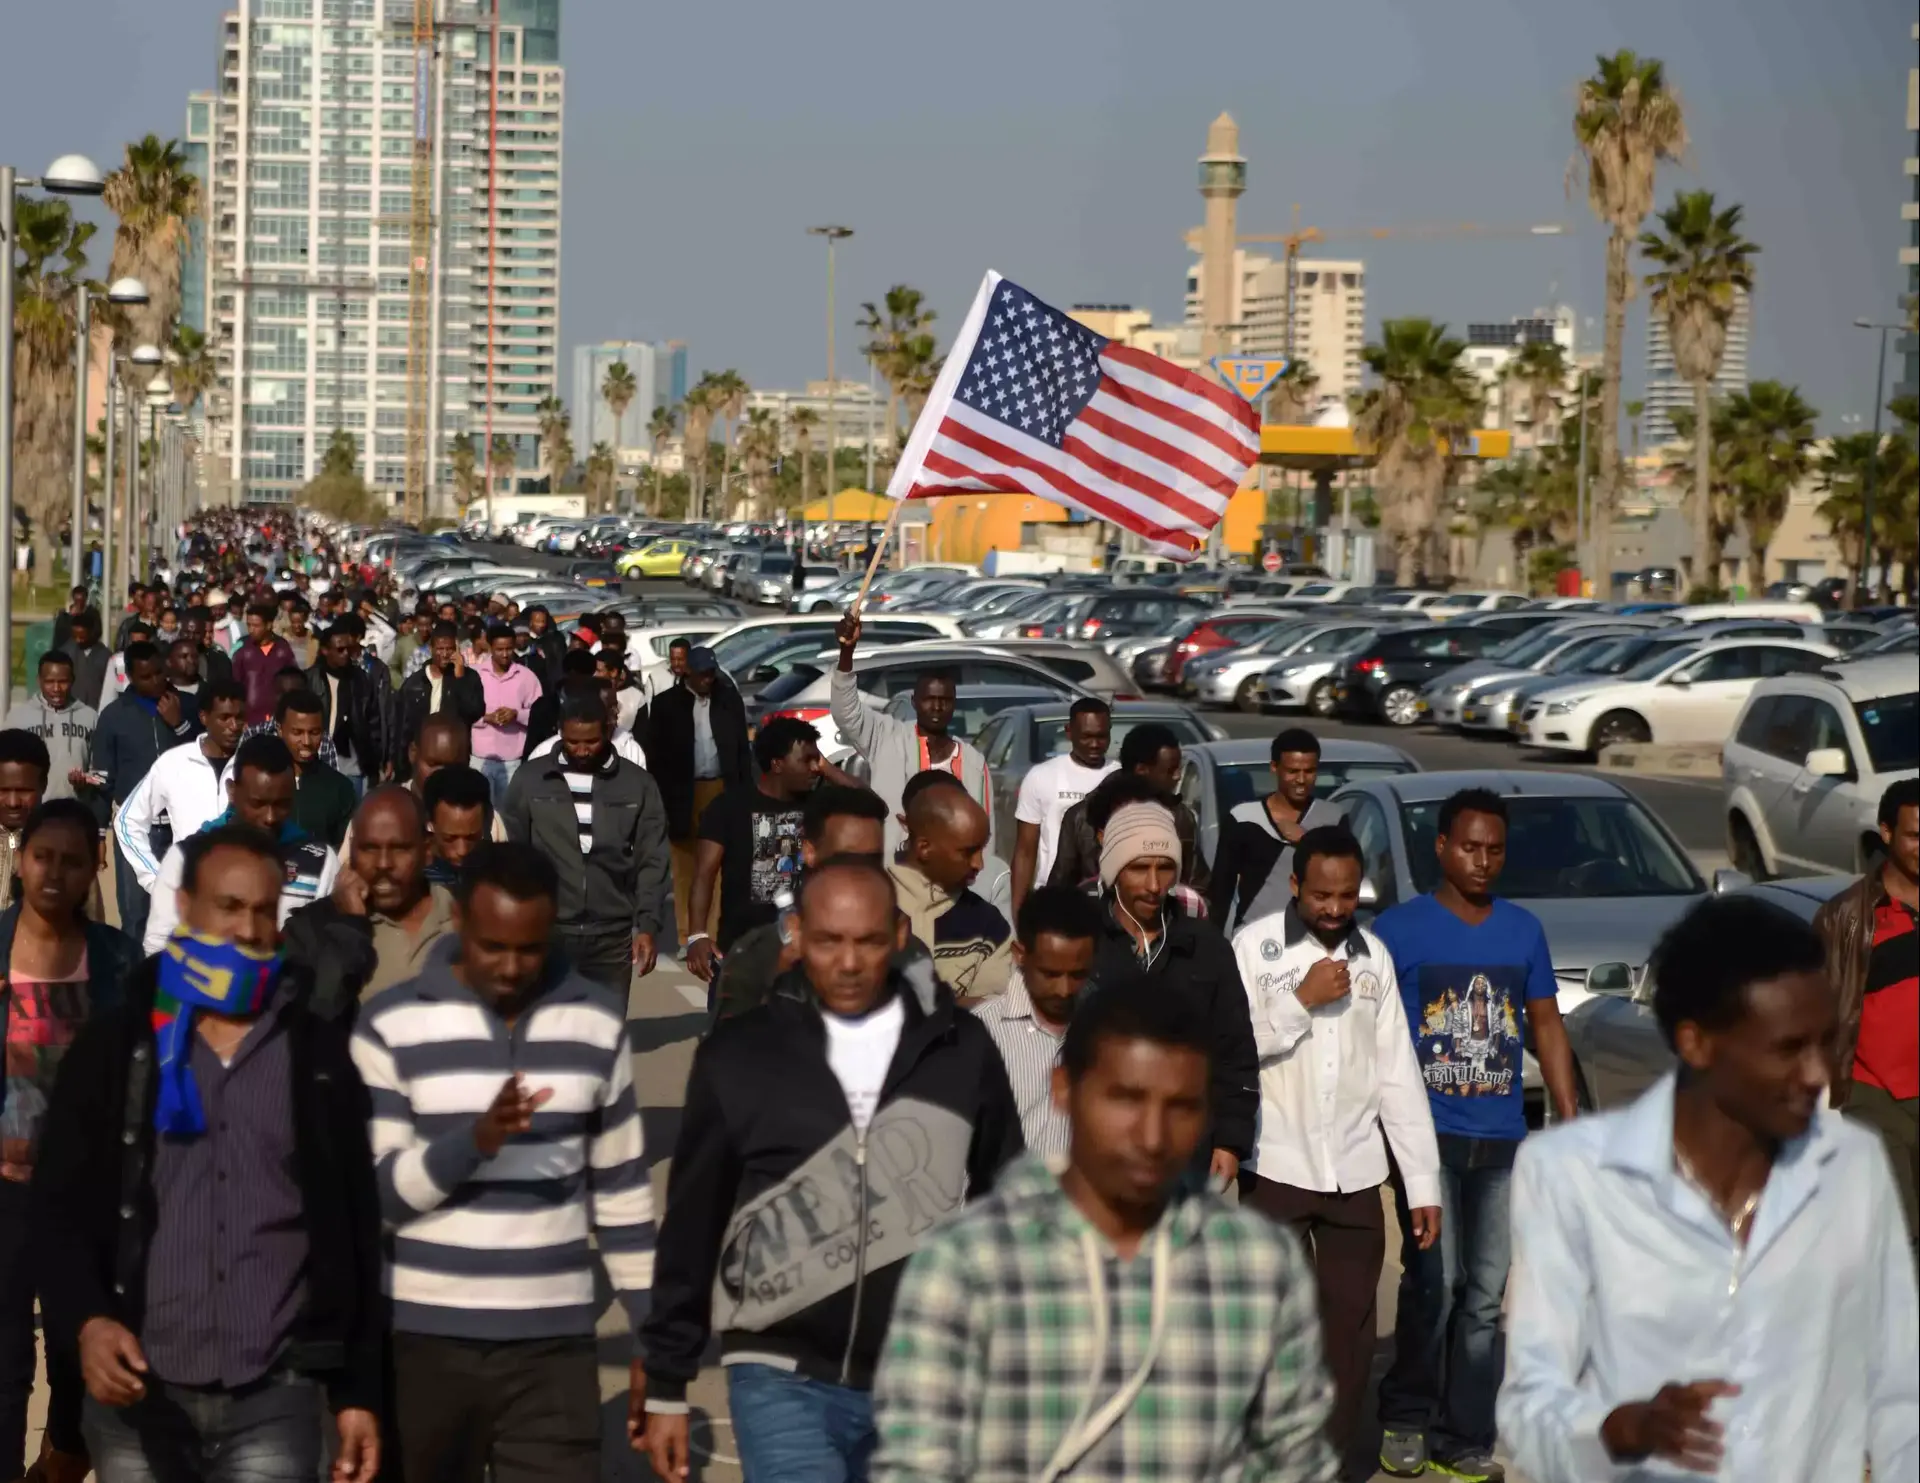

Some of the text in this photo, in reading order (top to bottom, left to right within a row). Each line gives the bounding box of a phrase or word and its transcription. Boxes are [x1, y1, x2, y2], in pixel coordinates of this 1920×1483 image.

[1235, 364, 1265, 382] פז
[1058, 791, 1085, 800] EXTR
[1258, 966, 1301, 992] Buenos
[724, 1115, 961, 1280] WEAR
